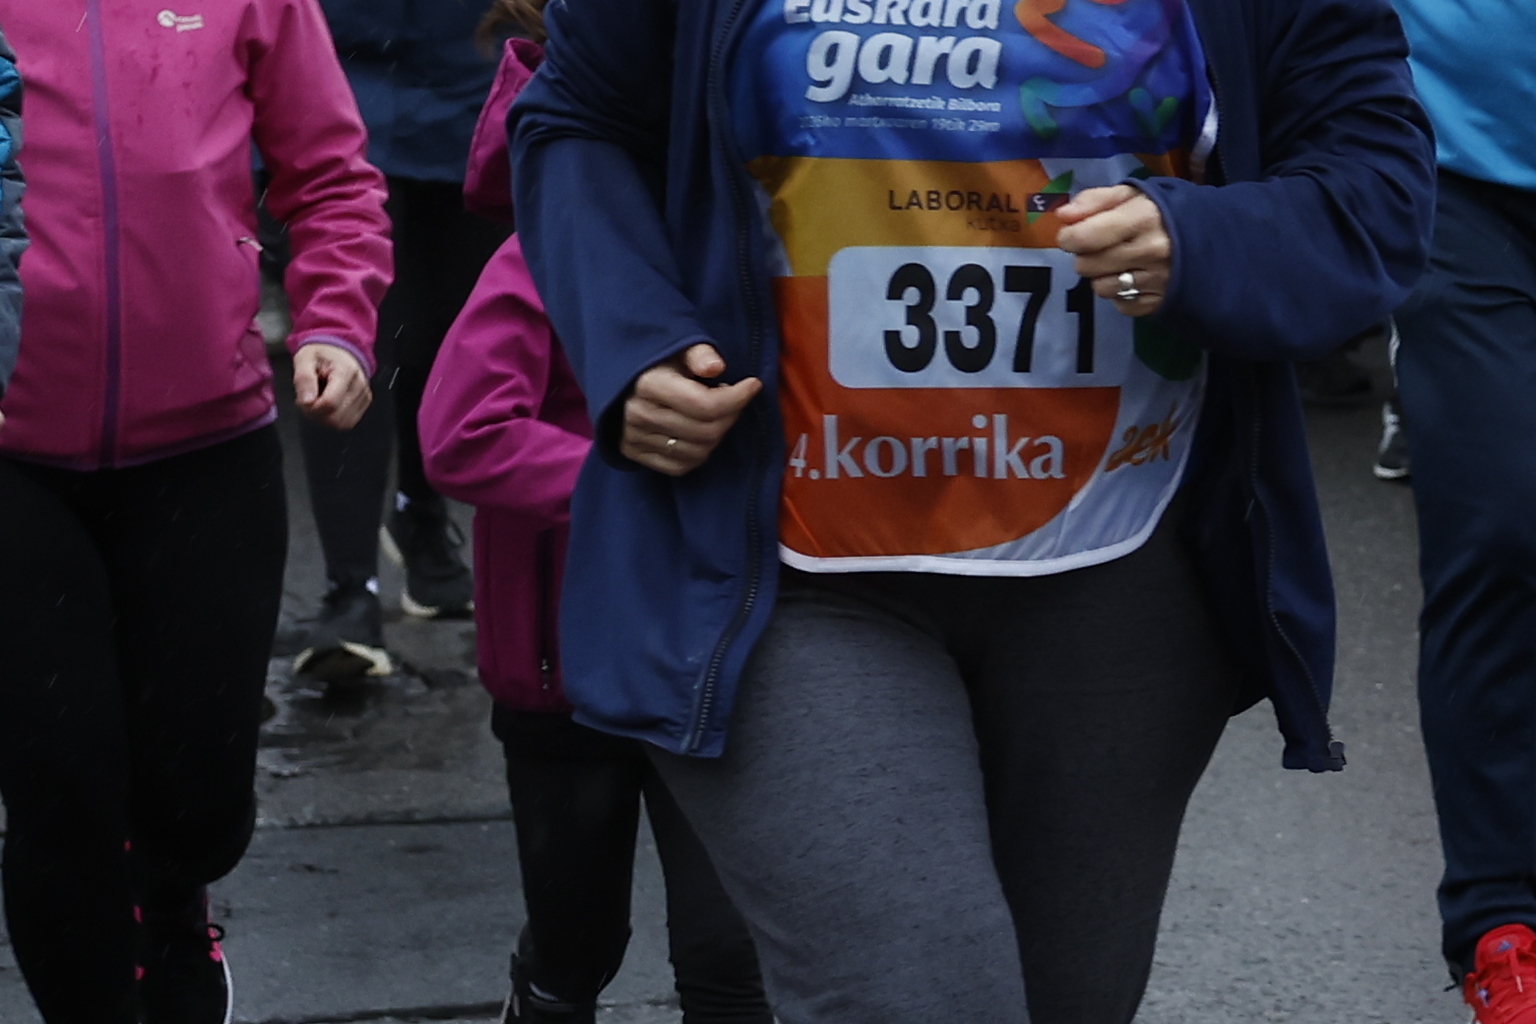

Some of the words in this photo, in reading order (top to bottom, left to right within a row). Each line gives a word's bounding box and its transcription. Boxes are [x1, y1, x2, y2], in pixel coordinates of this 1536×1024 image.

[805, 30, 1003, 102] gara
[888, 189, 1019, 214] LABORAL
[883, 262, 1095, 374] 3371
[788, 414, 1067, 480] 4.korrika
